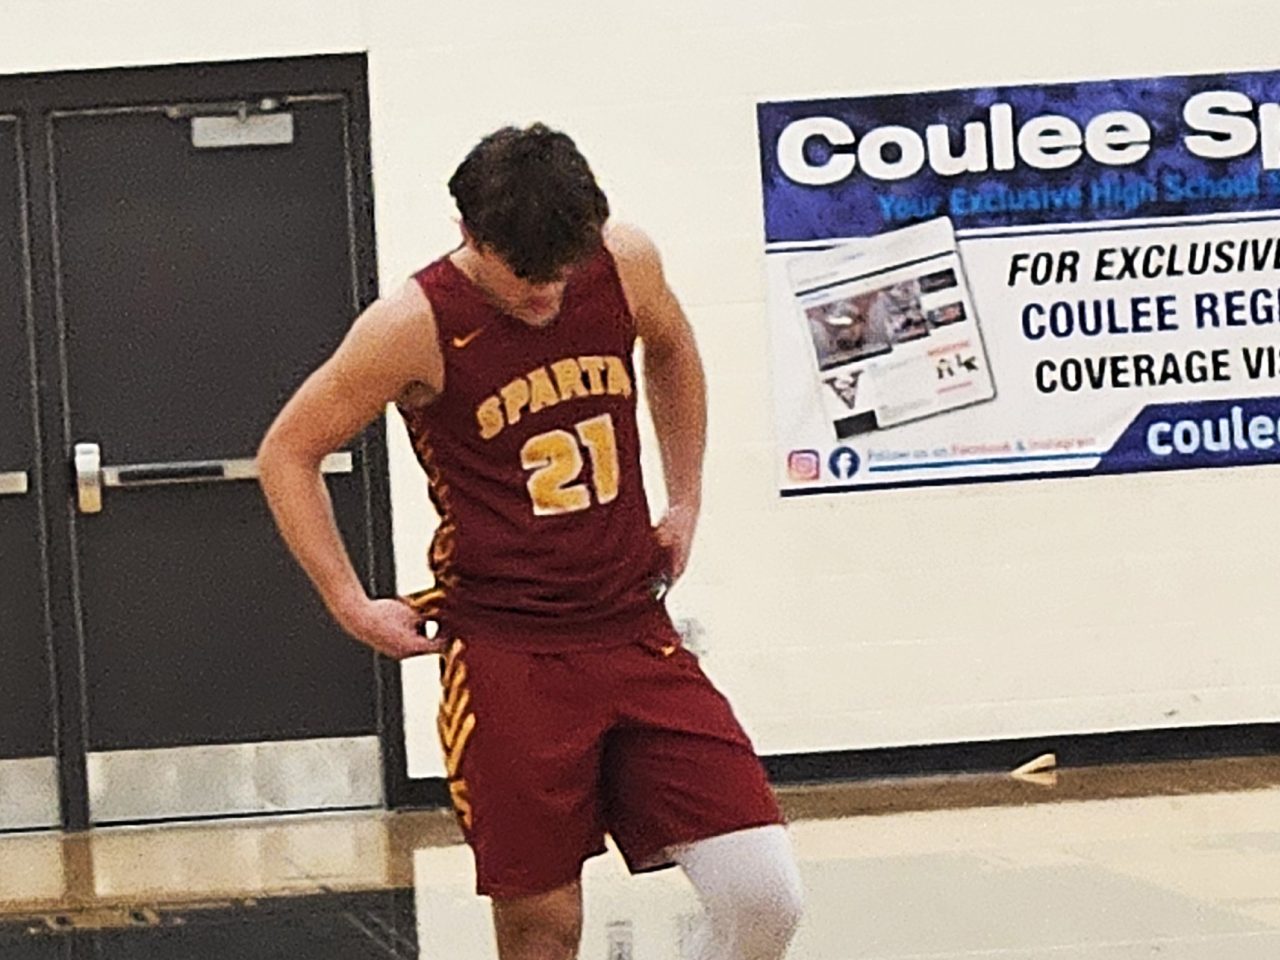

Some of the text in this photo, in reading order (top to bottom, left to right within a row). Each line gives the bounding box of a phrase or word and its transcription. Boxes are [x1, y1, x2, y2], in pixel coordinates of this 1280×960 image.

[777, 103, 1151, 186] Coulee
[950, 187, 1082, 216] Exclusive
[1091, 178, 1156, 210] High
[1163, 167, 1259, 200] School
[1008, 250, 1080, 286] FOR
[1022, 295, 1179, 340] COULEE
[1036, 349, 1231, 393] COVERAGE
[475, 355, 633, 440] SPARTA
[520, 413, 619, 516] 21
